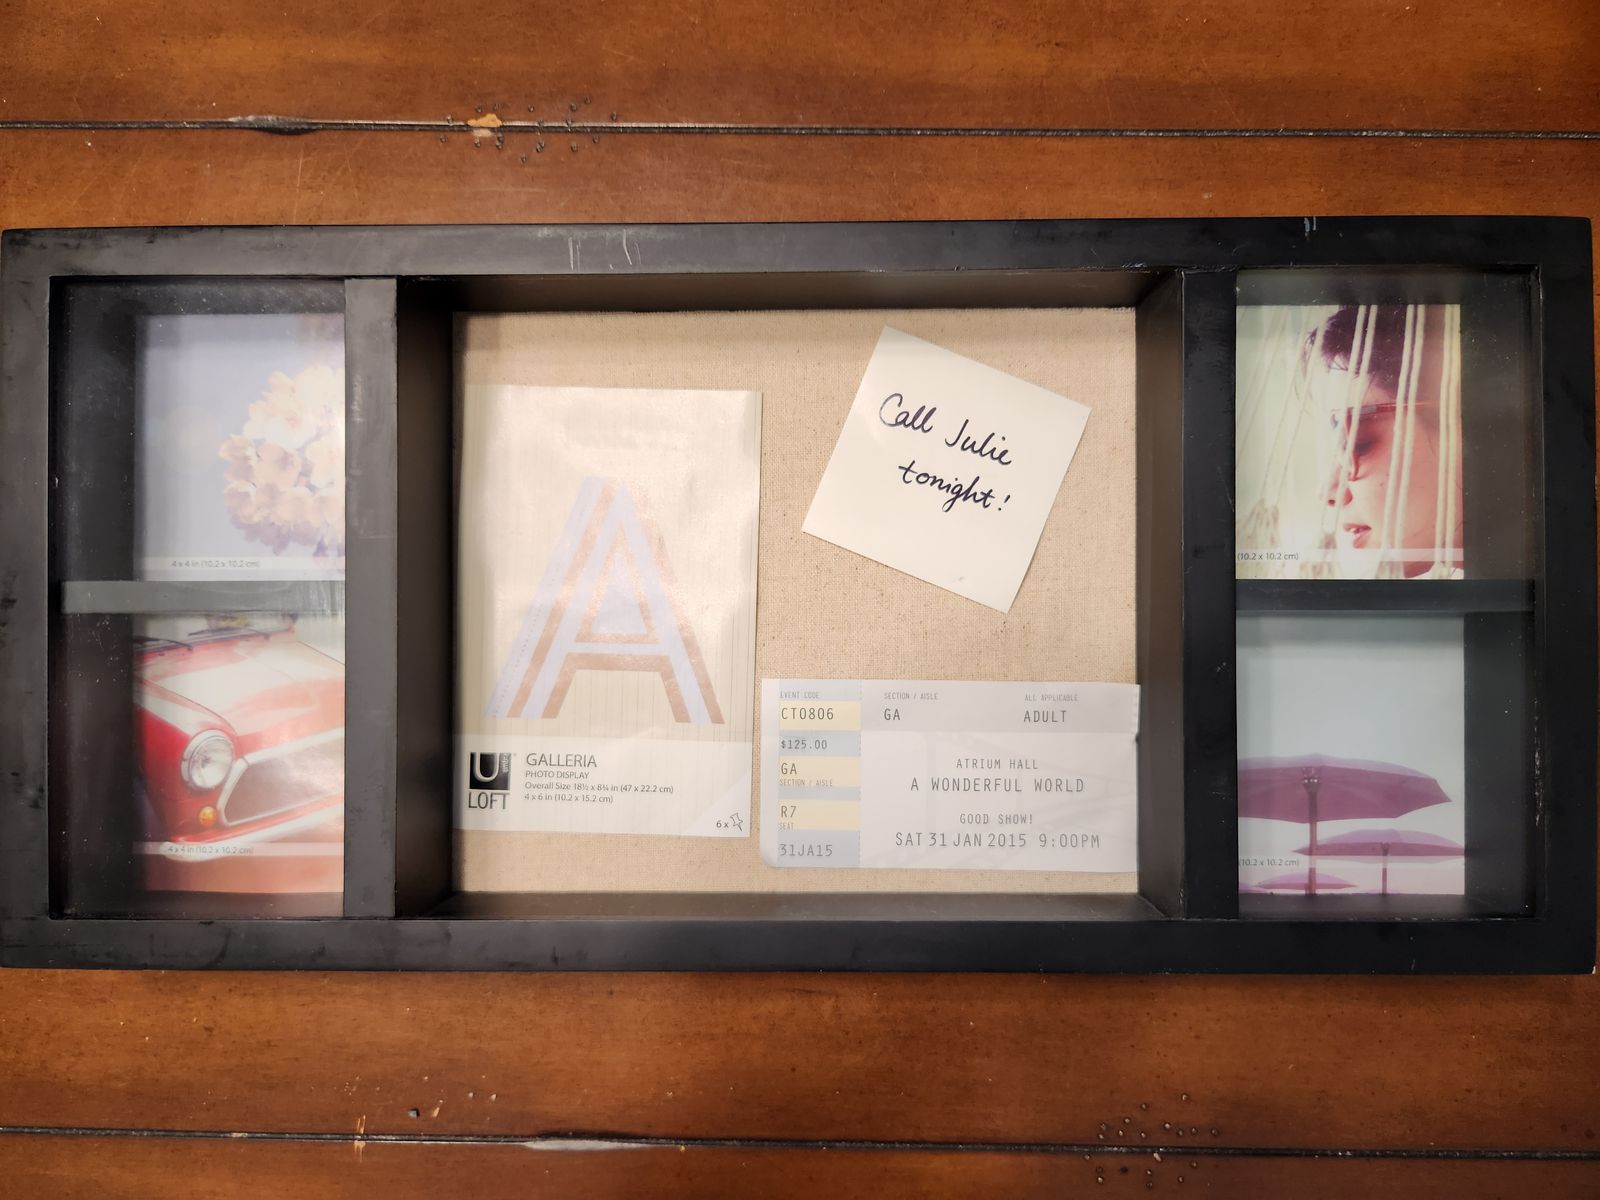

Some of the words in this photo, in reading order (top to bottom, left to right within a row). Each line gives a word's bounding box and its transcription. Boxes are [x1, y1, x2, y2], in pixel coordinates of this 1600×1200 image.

[879, 393, 937, 433] Call
[944, 418, 1012, 466] Julie
[898, 459, 1011, 513] tonight!
[1266, 552, 1282, 561] 10.2
[1284, 553, 1299, 561] cm)
[780, 691, 800, 699] EVENT
[884, 692, 910, 700] SECTION
[1024, 694, 1037, 702] ALL
[1040, 694, 1078, 702] APPLICABLE
[781, 707, 834, 720] CT0806
[883, 708, 901, 721] GA
[1023, 710, 1068, 723] ADULT
[781, 739, 828, 750] $125.00
[526, 753, 597, 767] GALLERIA
[956, 759, 1001, 769] ATRIUM
[1009, 760, 1039, 769] HALL
[525, 770, 555, 779] PHOTO
[556, 770, 590, 779] DISPLAY
[781, 762, 798, 775] GA
[524, 782, 554, 790] Overall
[611, 784, 619, 792] in
[620, 784, 632, 793] (47
[641, 785, 658, 793] 22.2
[659, 786, 674, 794] cm)
[780, 779, 806, 787] SECTION
[910, 778, 919, 791] A
[931, 778, 1022, 792] WONDERFUL
[1034, 779, 1084, 793] WORLD
[468, 791, 509, 809] LOFT
[554, 794, 573, 803] (10.2
[582, 795, 597, 803] 15.2
[598, 796, 614, 804] cm)
[781, 805, 797, 818] R7
[716, 820, 722, 828] 6
[960, 814, 990, 825] GOOD
[998, 814, 1033, 825] SHOW!
[780, 822, 794, 831] SEAT
[895, 832, 923, 847] SAT
[928, 833, 947, 847] 31
[953, 834, 982, 848] JAN
[987, 834, 1027, 848] 2015
[1039, 834, 1101, 849] 9:00PM
[780, 843, 833, 857] 31JA15
